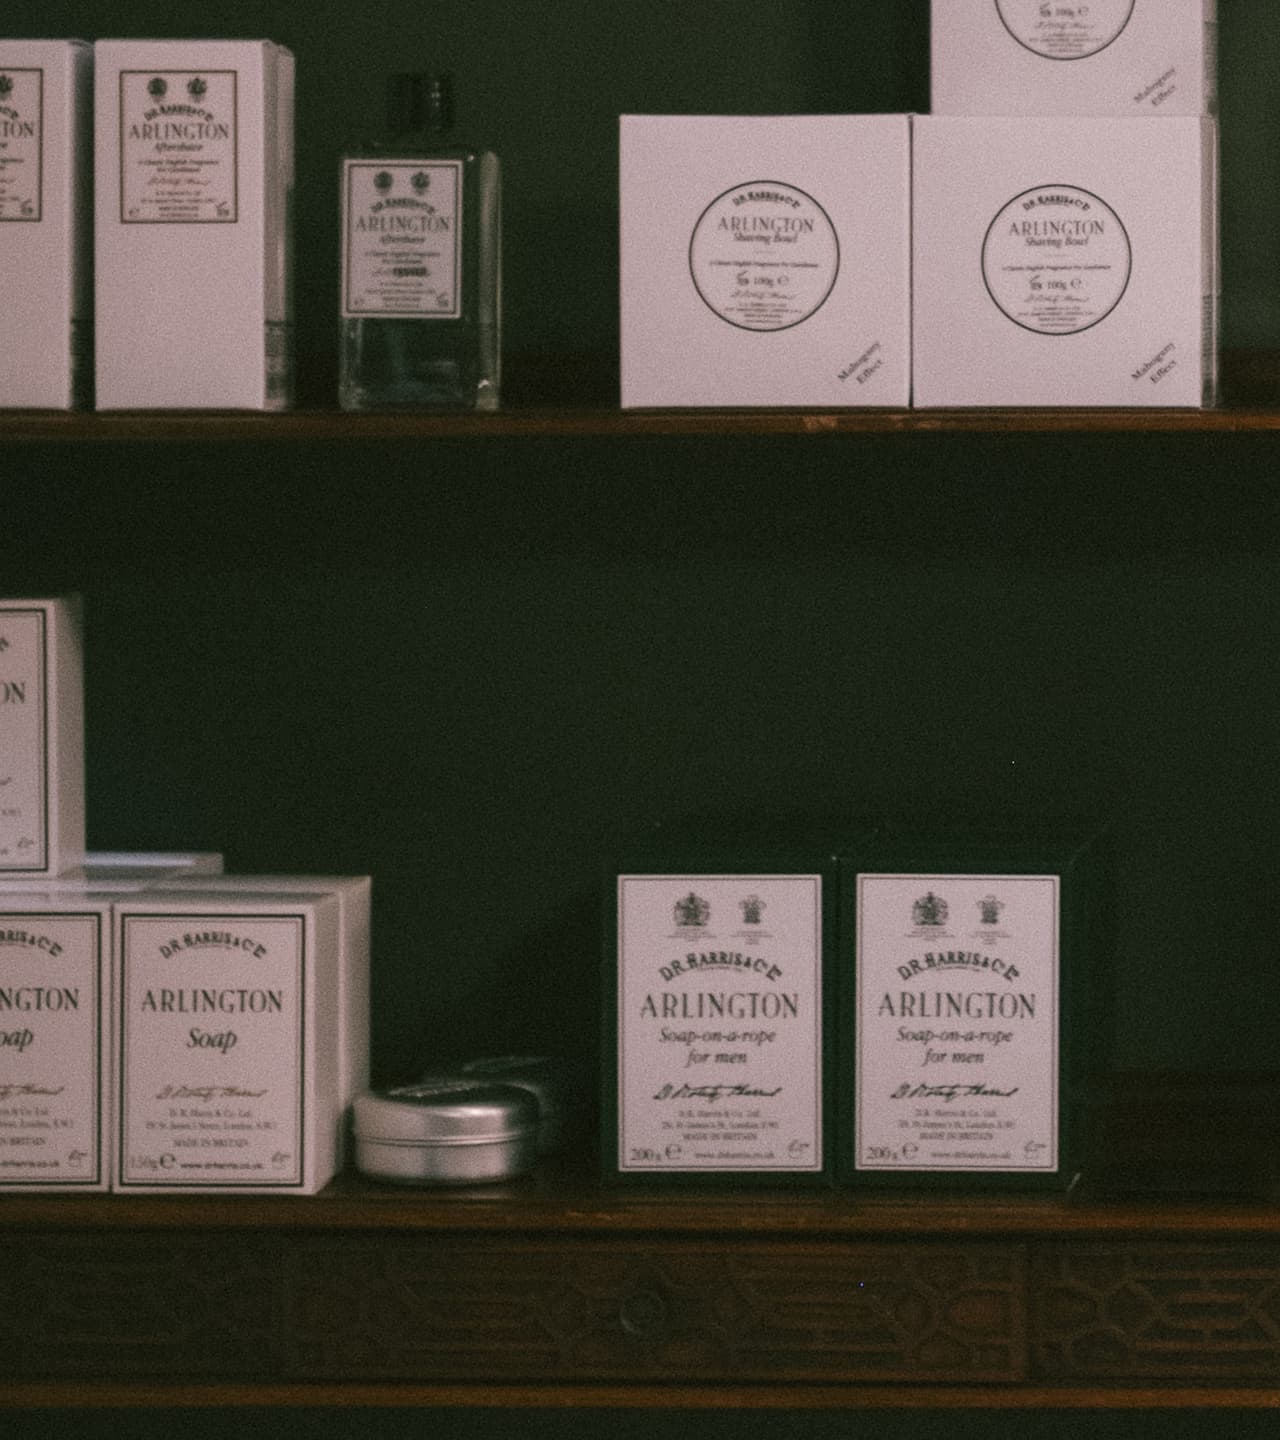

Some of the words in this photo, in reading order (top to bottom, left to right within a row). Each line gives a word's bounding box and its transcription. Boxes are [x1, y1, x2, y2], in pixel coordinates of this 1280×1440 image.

[128, 123, 229, 140] ARLINGTON
[355, 216, 449, 232] ARLINGTON
[718, 216, 814, 232] ARLINGTON
[1009, 220, 1105, 237] ARLINGTON
[0, 987, 80, 1011] NGTON
[141, 989, 283, 1013] ARLINGTON
[641, 991, 799, 1019] ARLINGTON
[878, 991, 1036, 1019] ARLINGTON
[0, 1028, 34, 1052] oap
[187, 1027, 237, 1054] Soap
[659, 1027, 776, 1047] Soap-on-a-rope
[896, 1026, 1013, 1046] Soap-on-a-rope
[685, 1049, 711, 1067] for
[715, 1052, 747, 1065] men
[922, 1049, 947, 1067] for
[952, 1052, 984, 1065] men
